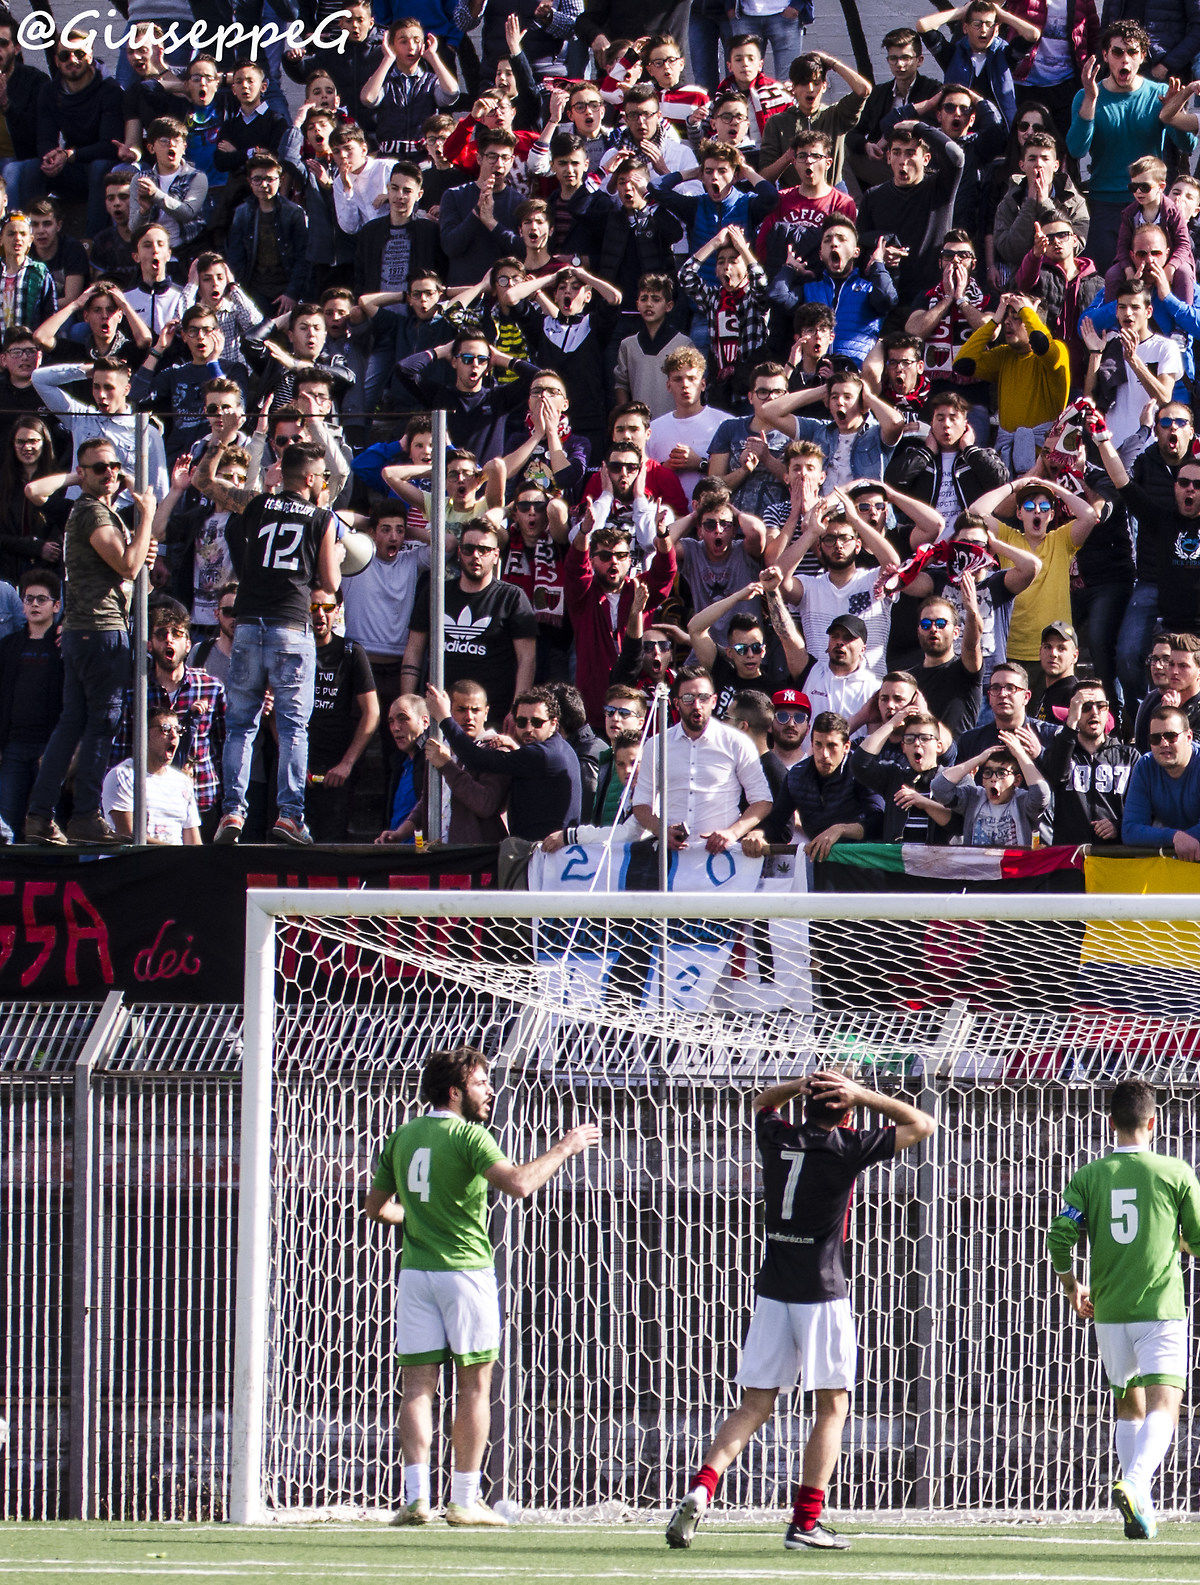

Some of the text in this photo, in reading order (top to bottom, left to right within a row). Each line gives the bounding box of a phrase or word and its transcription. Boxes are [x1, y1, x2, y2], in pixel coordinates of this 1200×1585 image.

[258, 522, 304, 571] 12
[561, 845, 597, 882] 2
[134, 919, 201, 983] dei
[407, 1147, 431, 1203] 4
[780, 1150, 806, 1221] 7
[1110, 1188, 1139, 1245] 5
